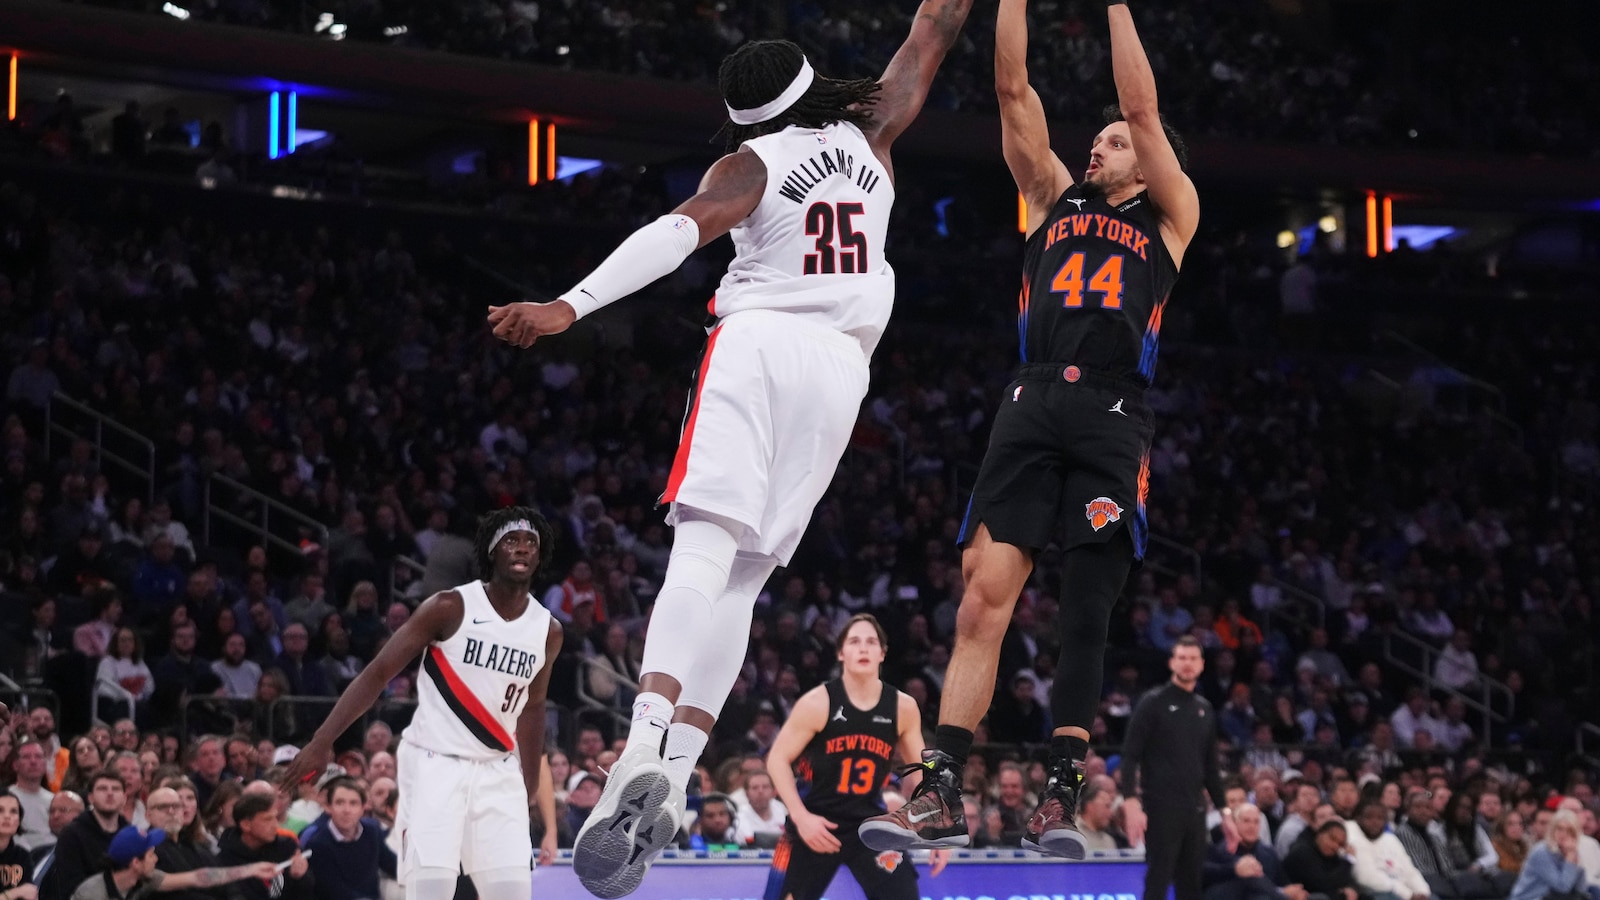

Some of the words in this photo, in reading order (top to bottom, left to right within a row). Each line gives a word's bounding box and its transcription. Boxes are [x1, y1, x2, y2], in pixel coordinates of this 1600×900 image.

[779, 148, 854, 205] WILLIAMS
[856, 165, 880, 194] III
[803, 201, 868, 275] 35
[1044, 213, 1094, 252] NEW
[1094, 213, 1150, 262] YORK
[1049, 250, 1126, 310] 44
[463, 637, 537, 680] BLAZERS
[501, 683, 526, 714] 91
[825, 734, 859, 755] NEW
[859, 734, 893, 760] YORK
[836, 757, 876, 795] 13
